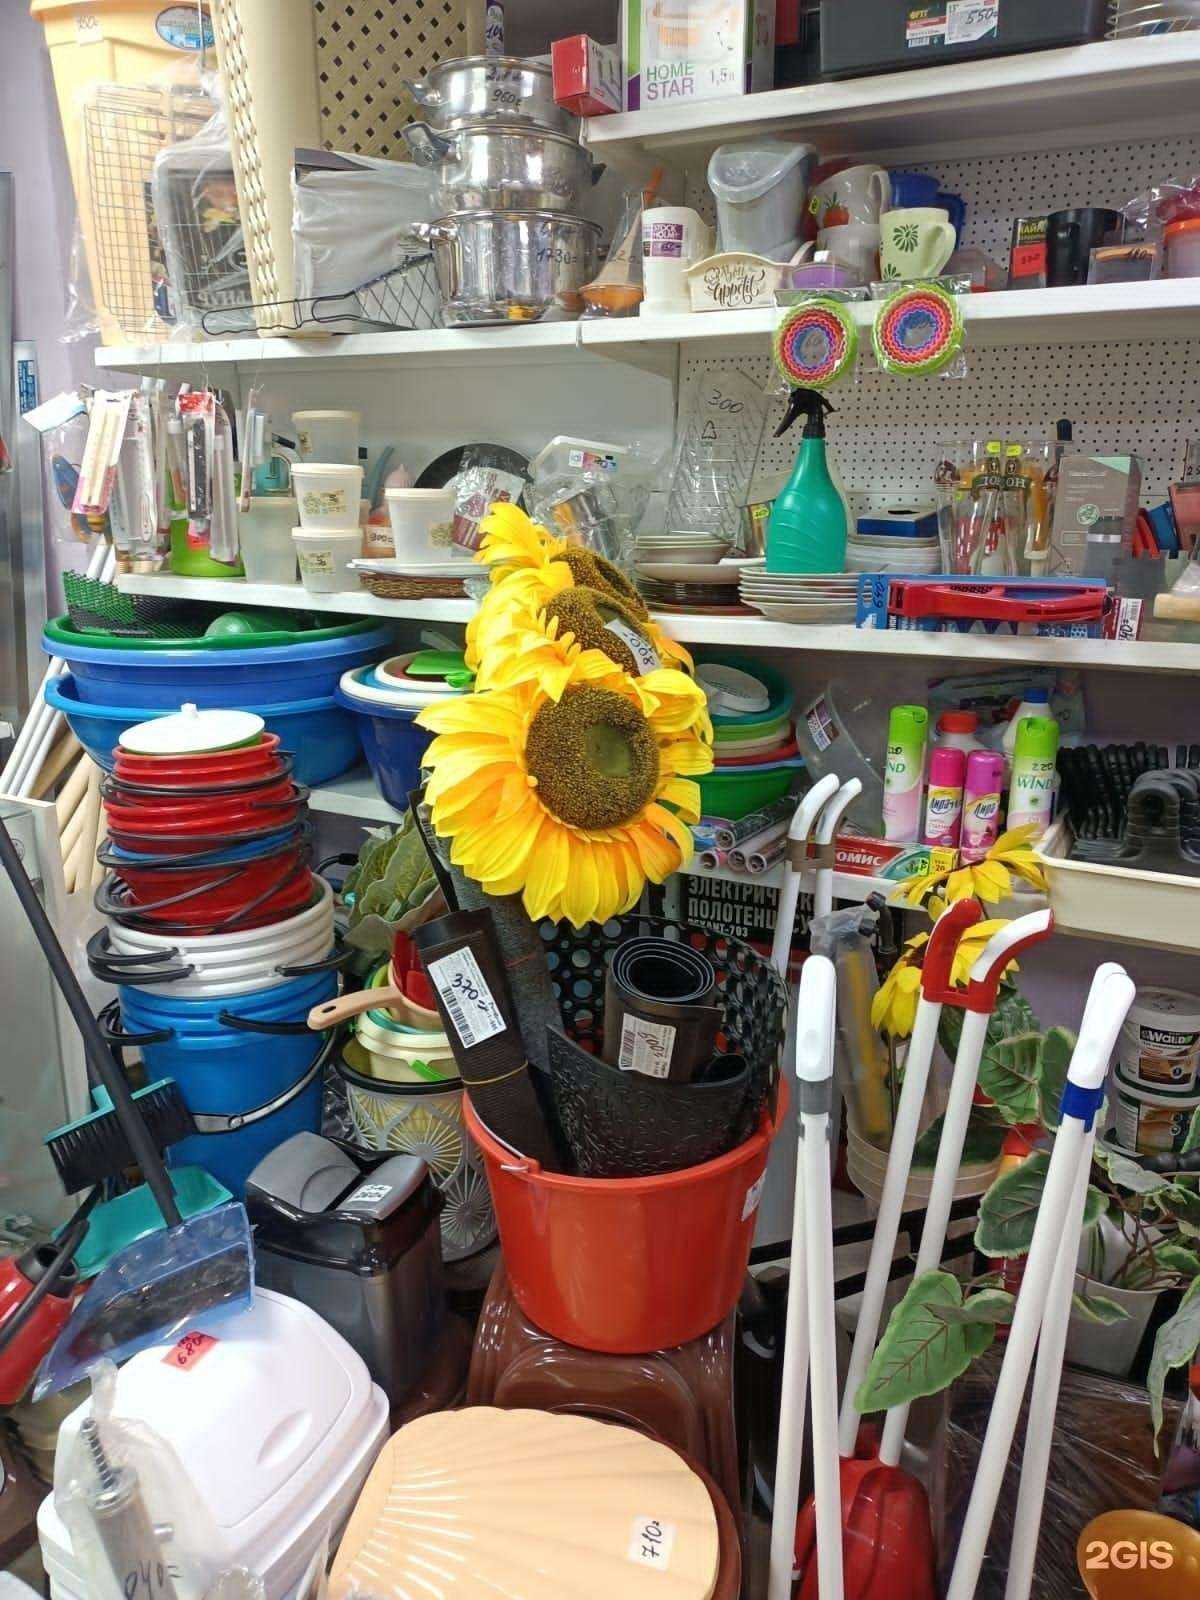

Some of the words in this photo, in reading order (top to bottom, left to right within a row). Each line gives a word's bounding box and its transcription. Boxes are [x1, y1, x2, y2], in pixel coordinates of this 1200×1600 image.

[646, 61, 695, 82] HOME
[647, 77, 695, 100] STAR
[707, 388, 745, 413] 300
[836, 851, 883, 867] ОМИС
